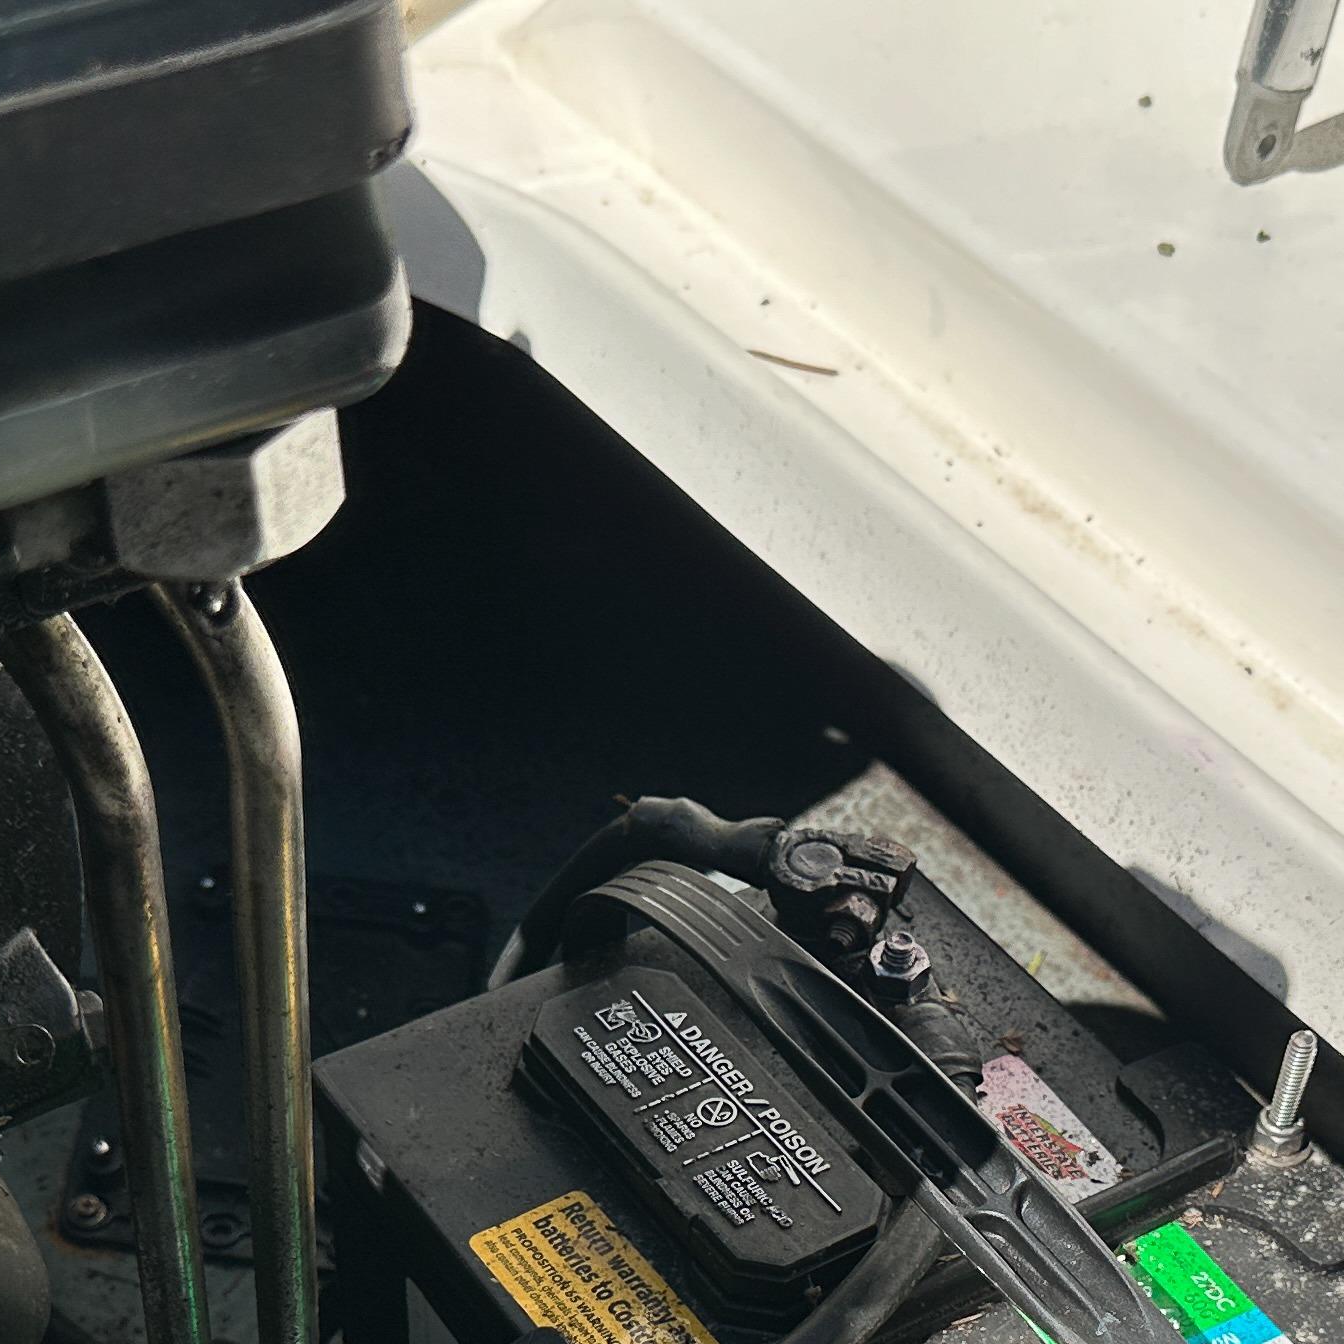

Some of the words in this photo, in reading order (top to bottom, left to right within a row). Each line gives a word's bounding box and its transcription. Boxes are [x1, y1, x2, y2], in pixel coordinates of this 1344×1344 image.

[572, 1025, 593, 1042] CAN
[584, 1039, 612, 1064] CAUSE
[579, 1050, 596, 1063] OR
[602, 1041, 639, 1073] GASES
[614, 1036, 666, 1085] EXPLOSIVE
[644, 1051, 674, 1076] EYES
[657, 1045, 693, 1078] SHIELD
[677, 1024, 756, 1097] DANGER
[756, 1106, 831, 1175] POISON
[682, 1112, 704, 1128] NO
[1000, 1112, 1065, 1180] BATTERIES
[1010, 1103, 1085, 1182] INTERSTATE
[691, 1173, 724, 1202] SEVERE
[724, 1158, 774, 1206] SULFURIC
[765, 1202, 795, 1228] ACID
[728, 1180, 757, 1206] CAUSE
[508, 1226, 571, 1291] PROPOSITION
[562, 1288, 583, 1304] 65
[530, 1213, 605, 1284] batteries
[588, 1280, 618, 1302] to
[556, 1200, 620, 1258] Return
[599, 1252, 679, 1328] warranty
[1188, 1270, 1237, 1312] 27DC
